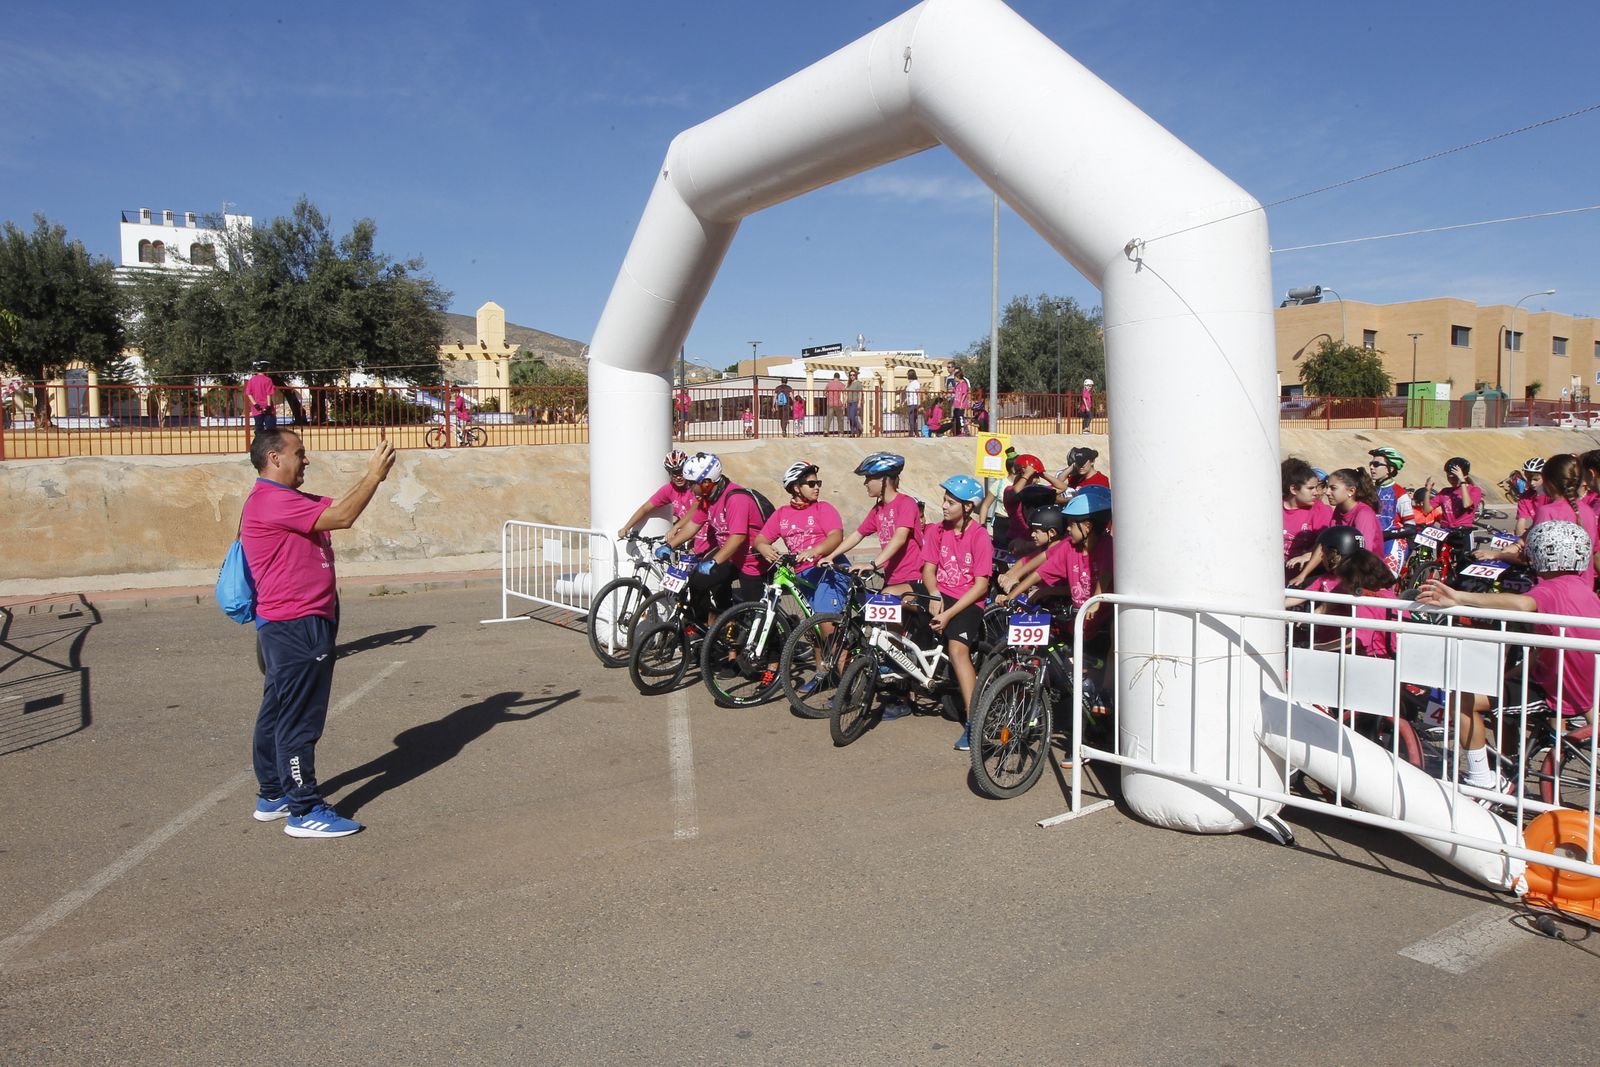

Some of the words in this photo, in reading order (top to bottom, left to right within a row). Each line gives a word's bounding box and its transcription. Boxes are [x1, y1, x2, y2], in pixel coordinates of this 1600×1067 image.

[1425, 528, 1445, 539] 280
[1467, 566, 1495, 577] 126
[662, 575, 681, 591] 241
[869, 606, 896, 620] 392
[1012, 628, 1044, 643] 399
